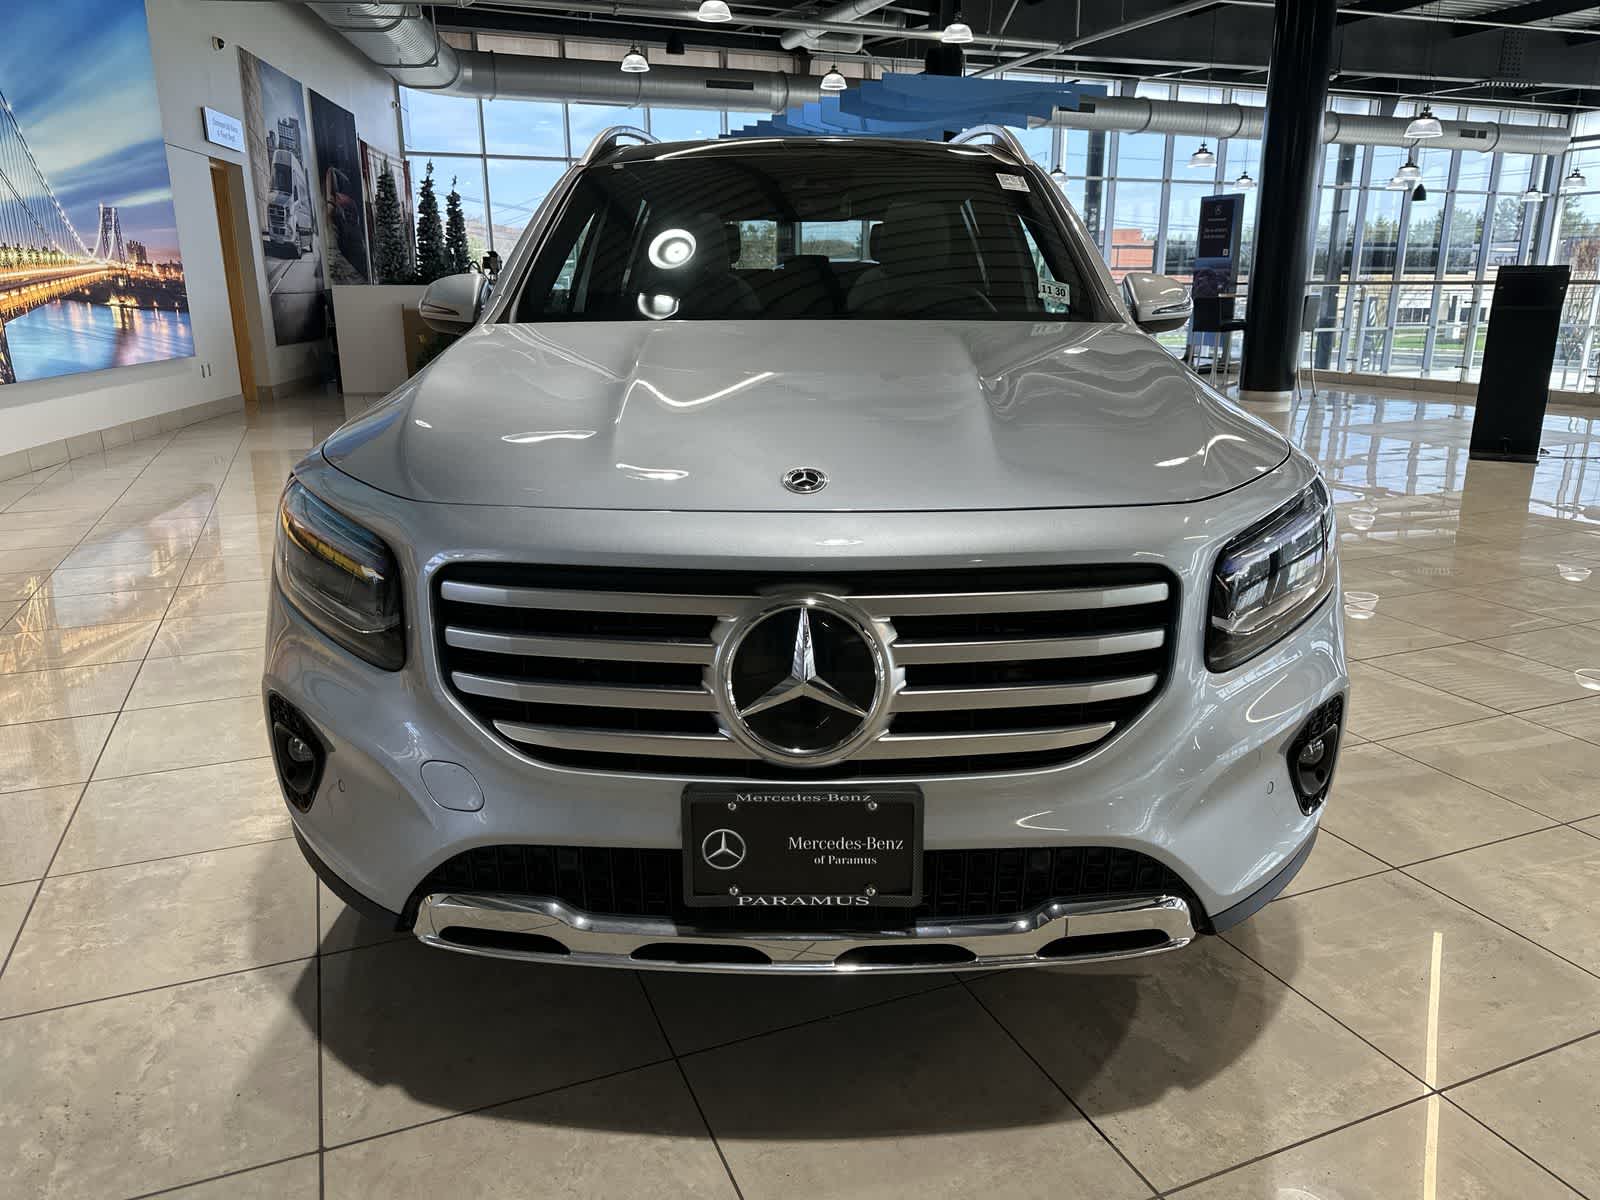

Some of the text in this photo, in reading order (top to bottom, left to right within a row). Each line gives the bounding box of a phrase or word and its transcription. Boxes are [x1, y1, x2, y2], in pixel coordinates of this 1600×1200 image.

[1042, 285, 1066, 297] 11 30
[736, 793, 871, 802] Mercedes-Benz
[788, 836, 904, 850] Mercedes-Benz
[814, 855, 877, 865] of Paramus
[737, 896, 870, 906] PARAMUS
